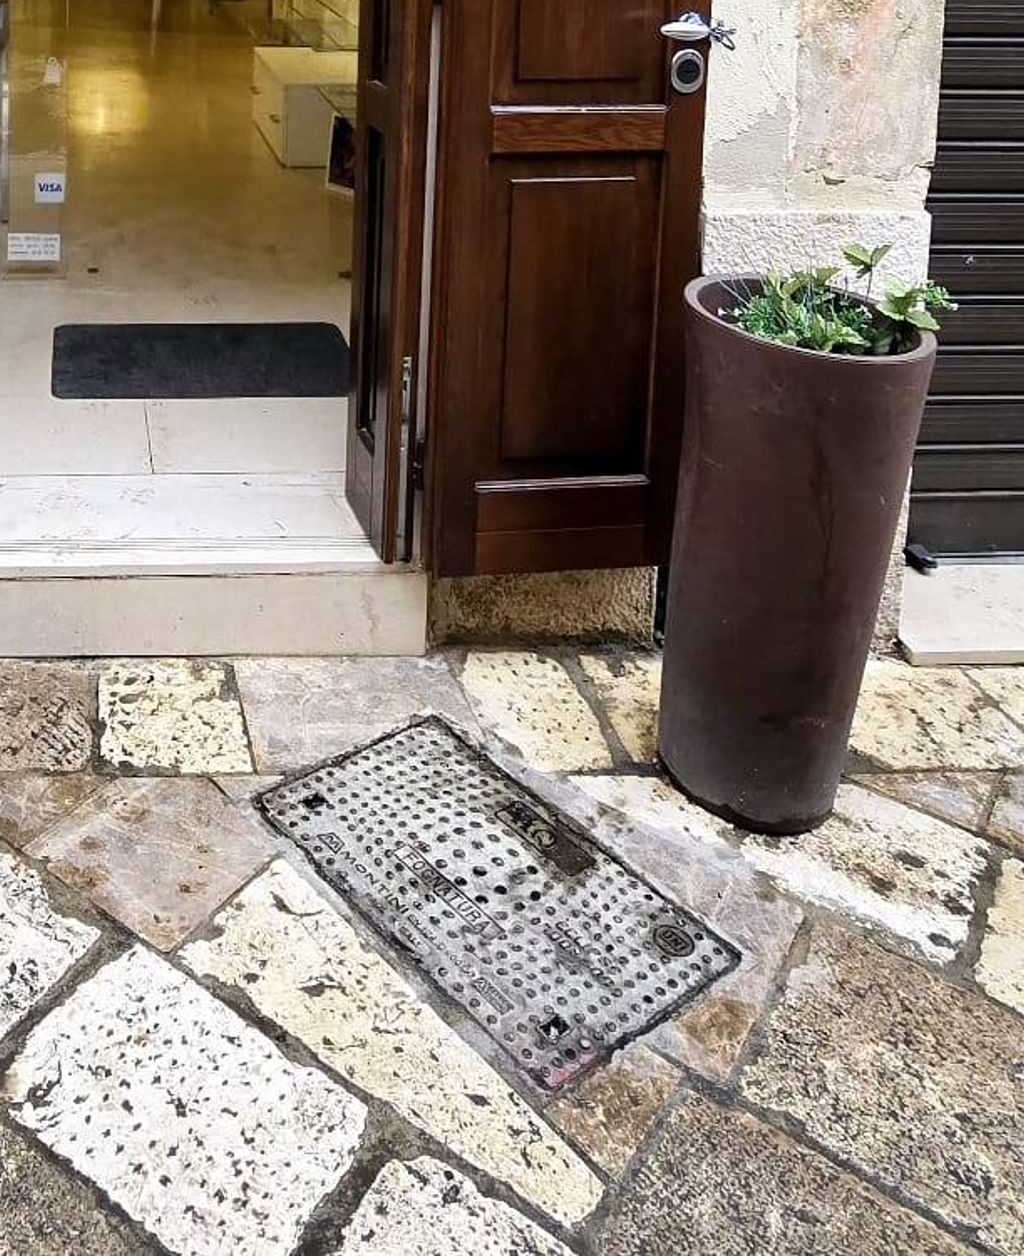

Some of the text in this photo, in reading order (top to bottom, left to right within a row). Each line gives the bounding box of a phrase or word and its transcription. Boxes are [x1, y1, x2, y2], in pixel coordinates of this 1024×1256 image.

[37, 182, 63, 192] VISA
[341, 851, 410, 915] MONTINI
[402, 850, 491, 935] FOGNATURA
